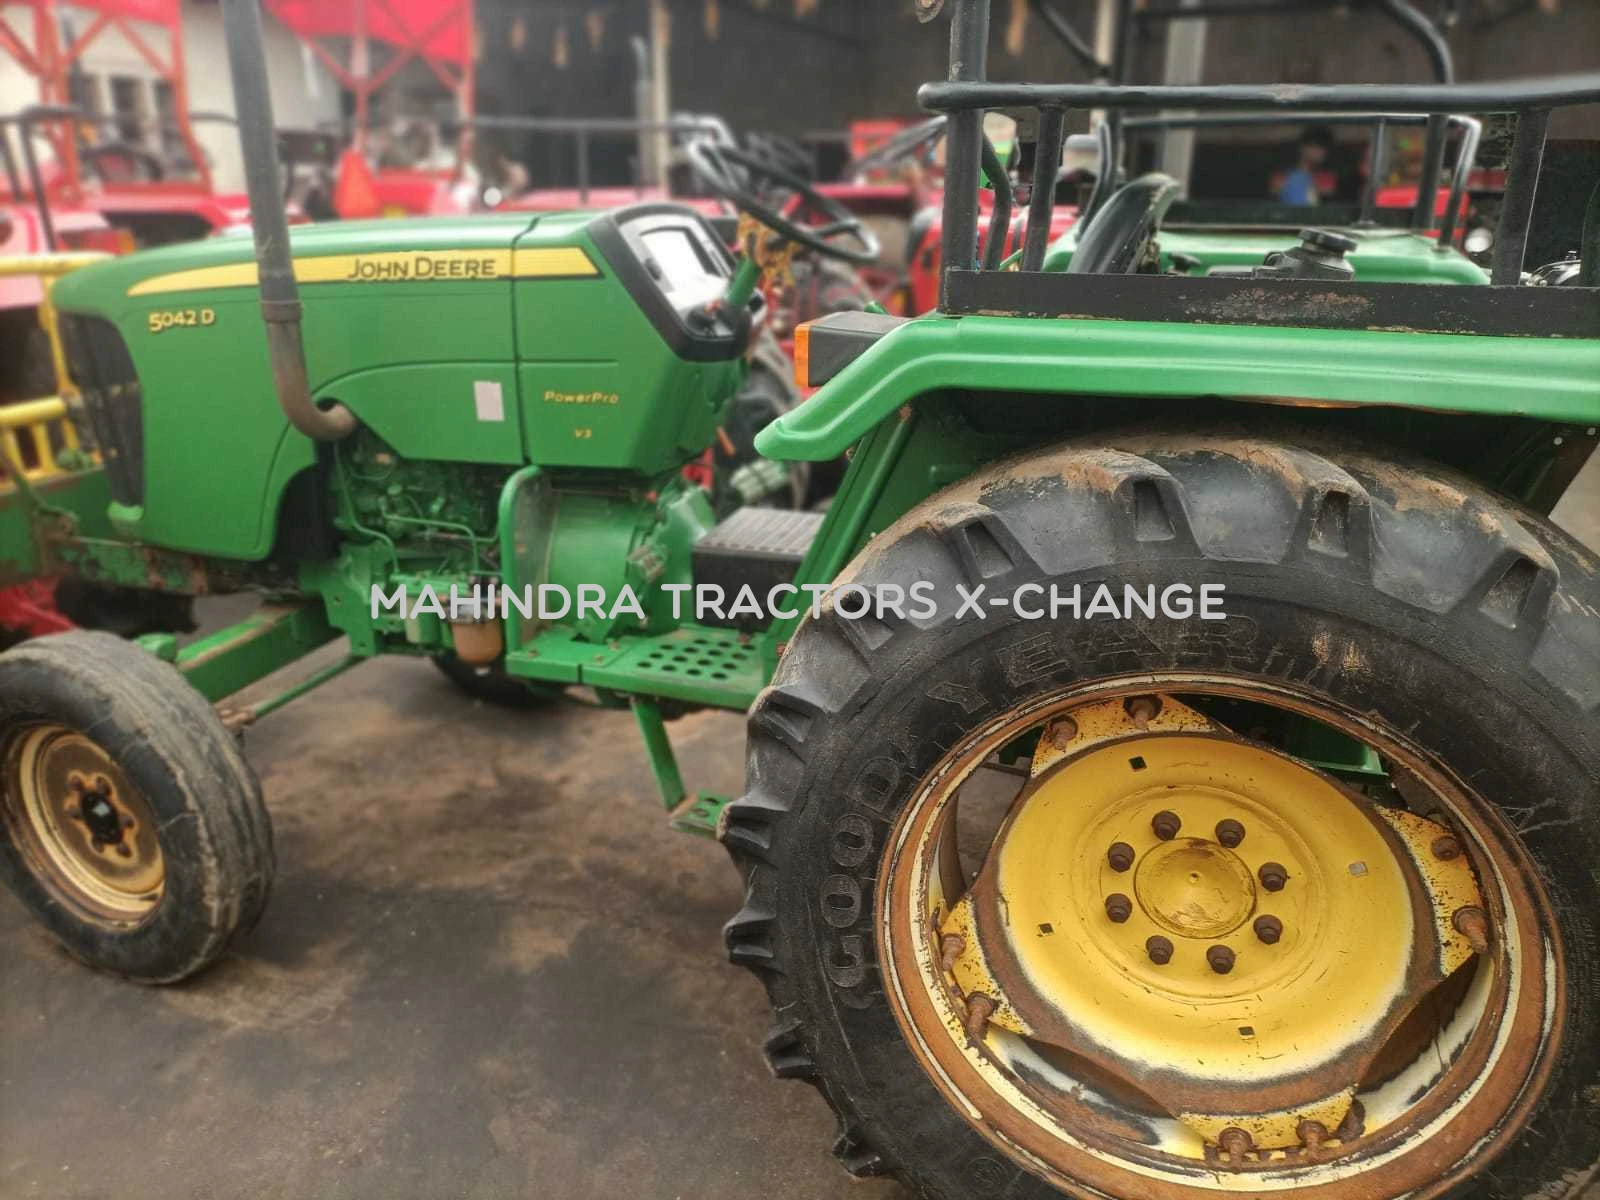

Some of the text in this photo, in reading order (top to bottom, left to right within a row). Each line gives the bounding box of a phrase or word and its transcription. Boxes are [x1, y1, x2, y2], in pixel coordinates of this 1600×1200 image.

[348, 257, 497, 280] JOHN DEERE
[148, 308, 215, 332] 5042 D
[543, 390, 620, 404] PowerPro
